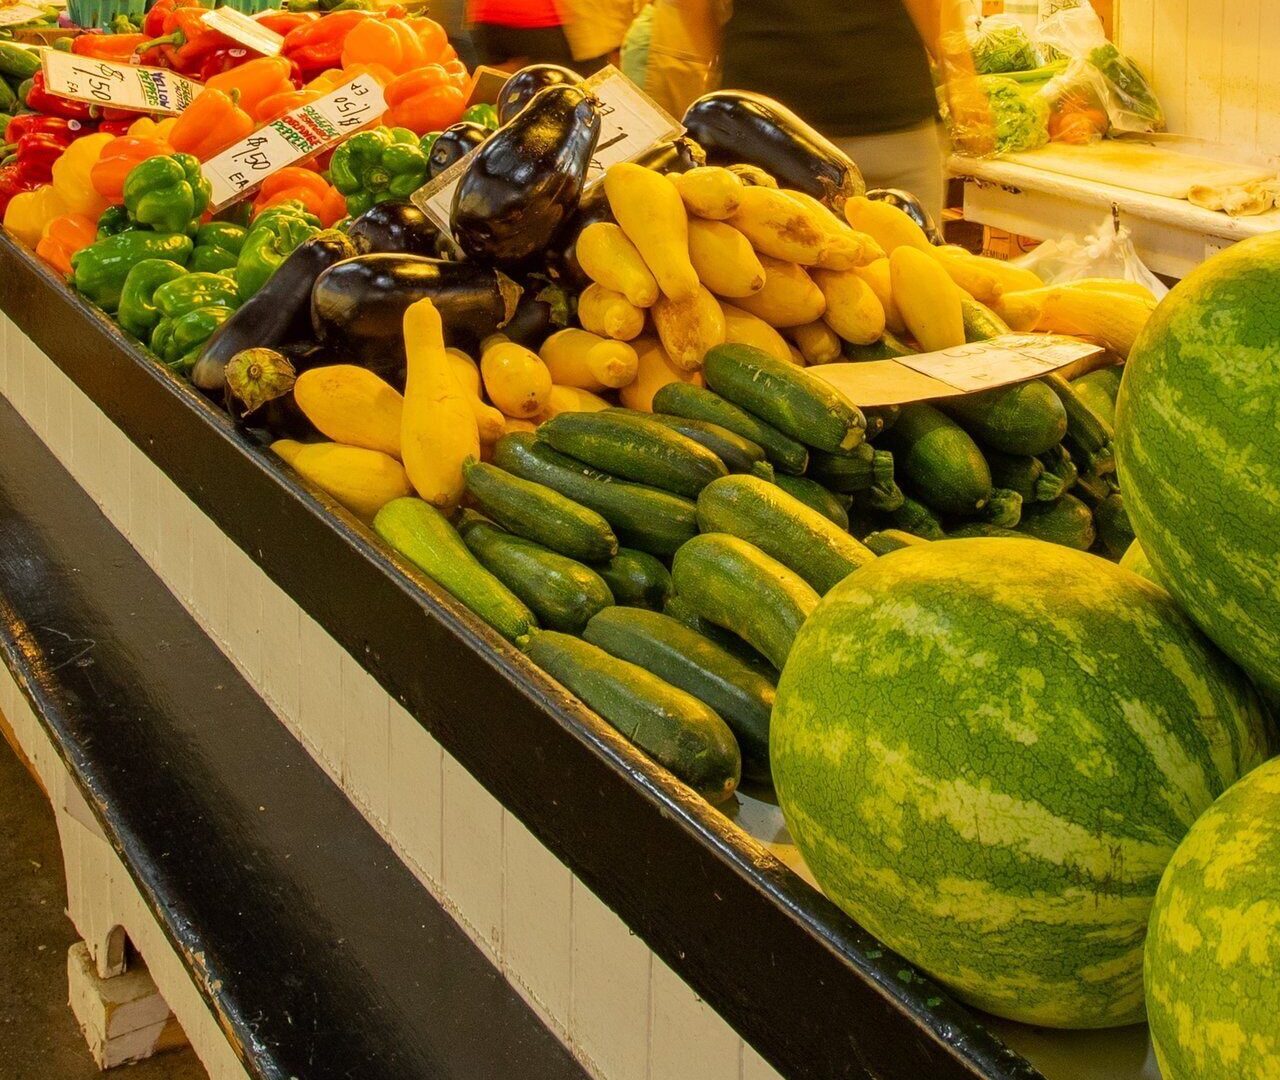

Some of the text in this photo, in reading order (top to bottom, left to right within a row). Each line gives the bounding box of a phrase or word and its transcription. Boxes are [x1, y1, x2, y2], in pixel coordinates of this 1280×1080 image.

[66, 81, 79, 94] EA
[137, 69, 160, 107] PEPPERS
[150, 72, 171, 110] YELLOW
[351, 83, 369, 97] EA
[270, 120, 314, 153] PEPPERS
[280, 115, 322, 147] ORANGE
[229, 172, 250, 189] EA
